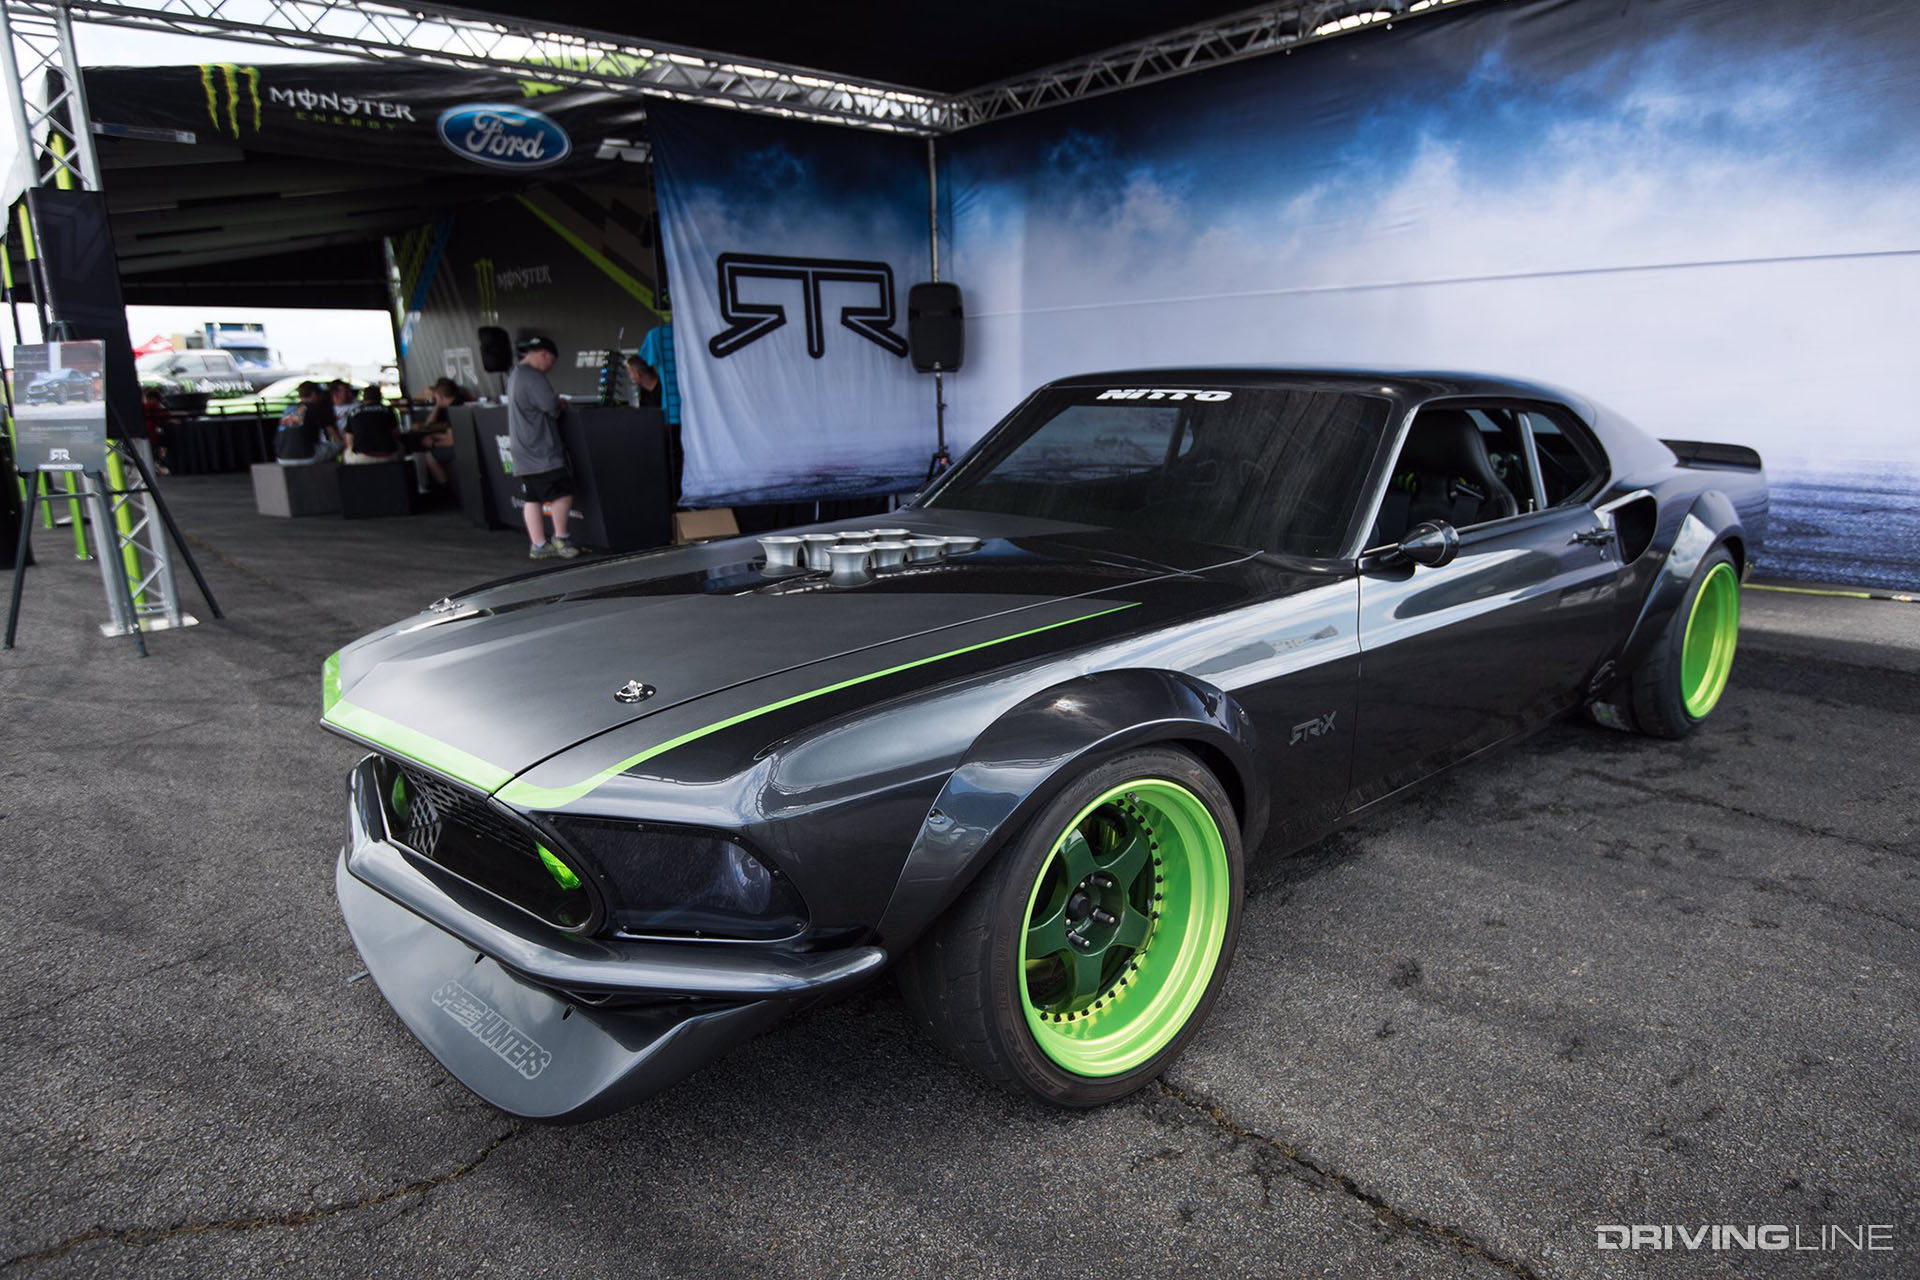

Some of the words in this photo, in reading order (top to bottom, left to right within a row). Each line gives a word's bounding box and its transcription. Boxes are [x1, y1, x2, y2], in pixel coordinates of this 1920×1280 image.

[269, 86, 416, 122] MONSTER
[295, 111, 397, 131] ENERGY
[466, 111, 545, 159] Ford
[1096, 389, 1233, 402] NITTO
